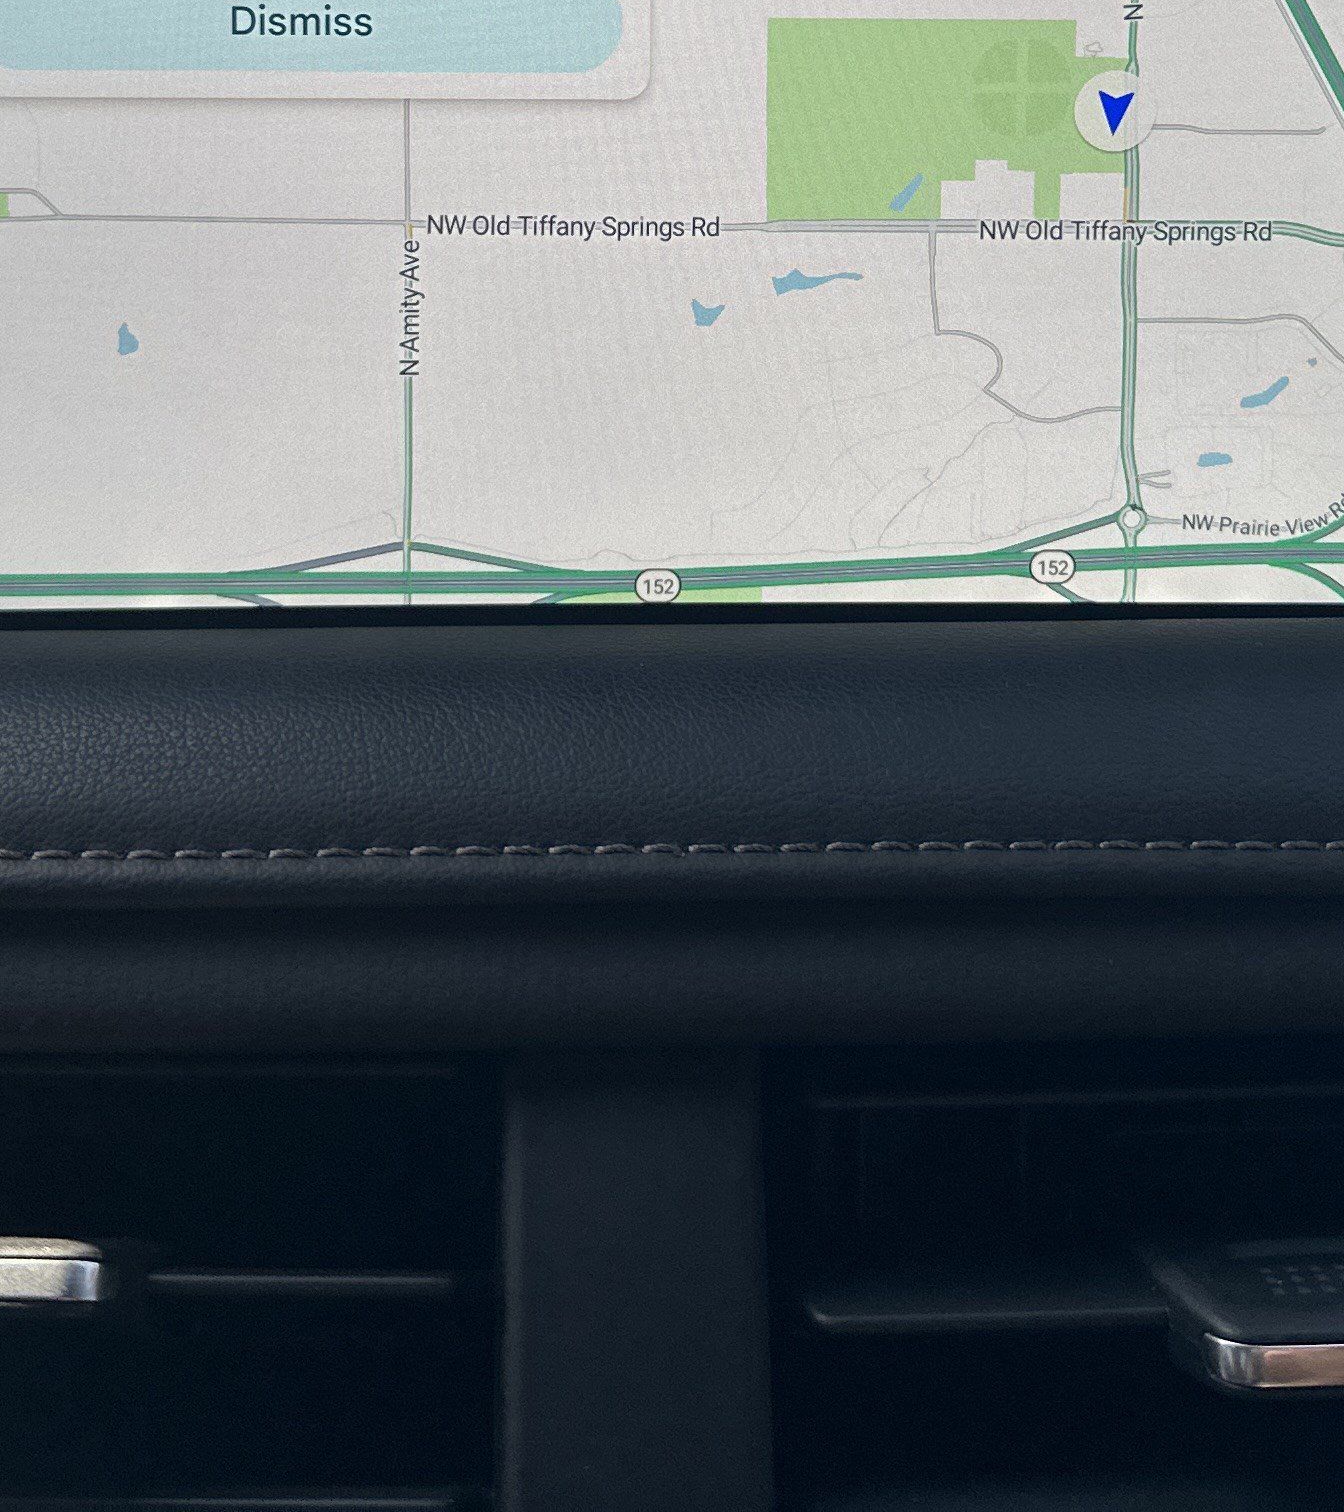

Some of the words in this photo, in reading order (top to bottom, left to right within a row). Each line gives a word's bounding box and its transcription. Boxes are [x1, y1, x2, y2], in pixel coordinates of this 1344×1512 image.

[231, 3, 373, 37] Dismiss
[1123, 3, 1144, 21] N
[426, 214, 467, 235] NW
[472, 215, 510, 236] Old
[518, 215, 597, 242] Tiffany
[601, 216, 685, 242] Springs
[691, 216, 720, 237] Rd
[979, 220, 1020, 240] NW
[1025, 220, 1063, 240] Old
[1070, 220, 1147, 246] Tiffany
[1153, 221, 1236, 246] Springs
[1243, 221, 1272, 241] Rd
[399, 239, 420, 281] Ave
[399, 287, 425, 353] Amity
[399, 359, 420, 376] N
[1182, 513, 1214, 531] NW
[1219, 516, 1280, 536] Prairie
[1285, 512, 1328, 535] View
[1037, 557, 1070, 577] 152
[643, 576, 675, 596] 152
